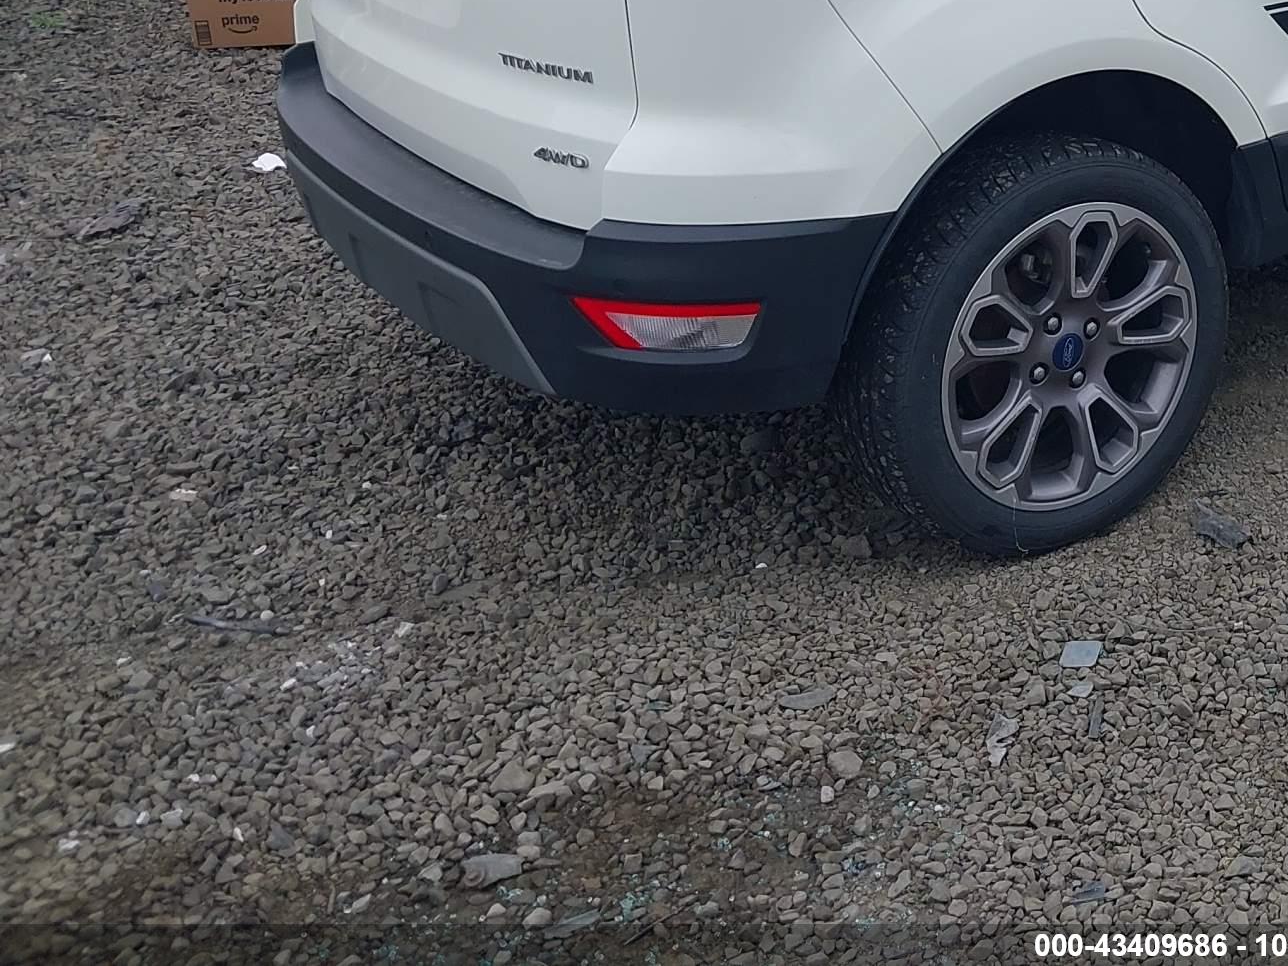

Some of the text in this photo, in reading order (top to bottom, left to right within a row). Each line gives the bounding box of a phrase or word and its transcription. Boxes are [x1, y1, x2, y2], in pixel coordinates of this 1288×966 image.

[221, 13, 260, 28] prime
[498, 52, 594, 84] TITANIUM
[533, 147, 589, 169] 4WD
